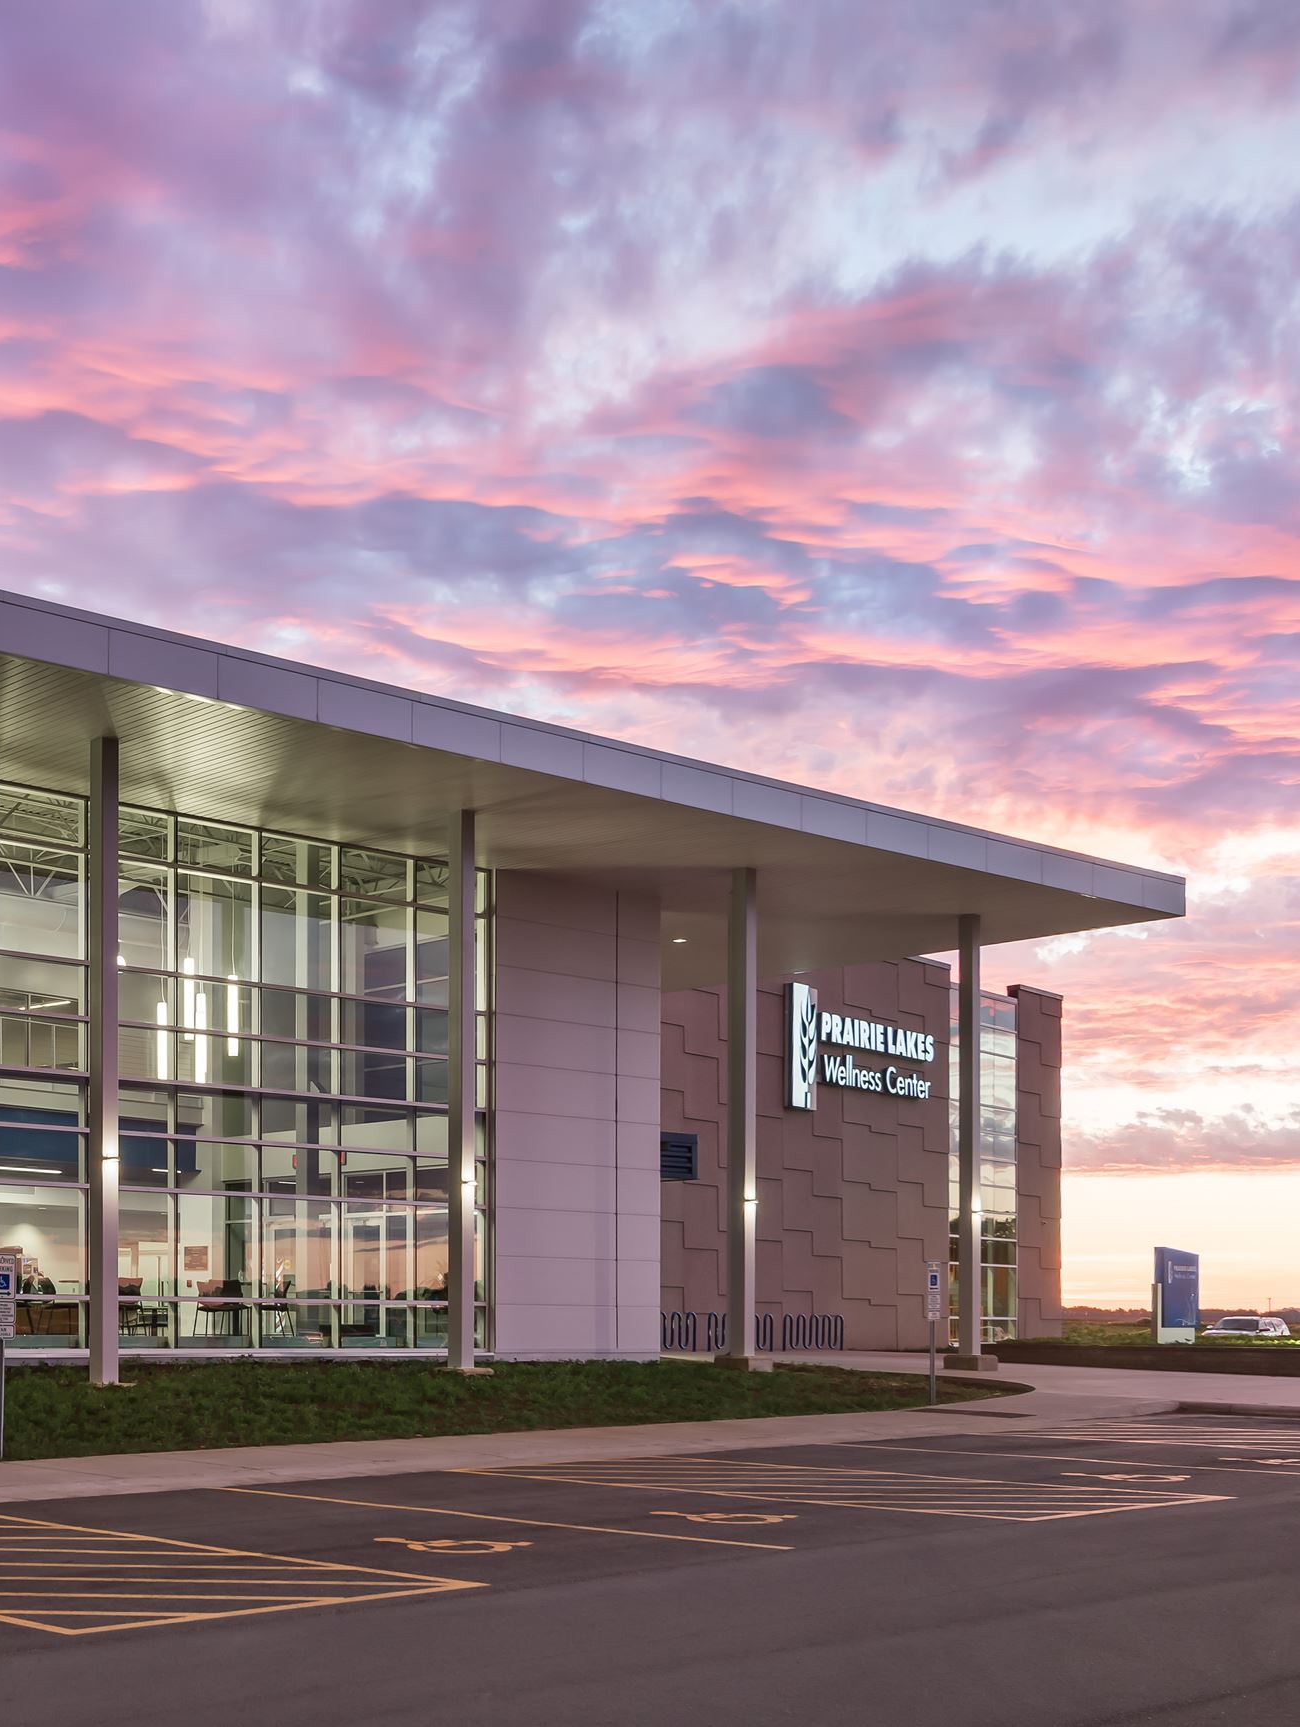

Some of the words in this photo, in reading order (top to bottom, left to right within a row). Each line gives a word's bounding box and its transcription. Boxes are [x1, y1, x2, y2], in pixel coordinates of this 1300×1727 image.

[821, 1011, 885, 1052] PRAIRIE
[887, 1026, 934, 1062] LAKES
[823, 1054, 882, 1092] Wellness
[886, 1066, 931, 1099] Center
